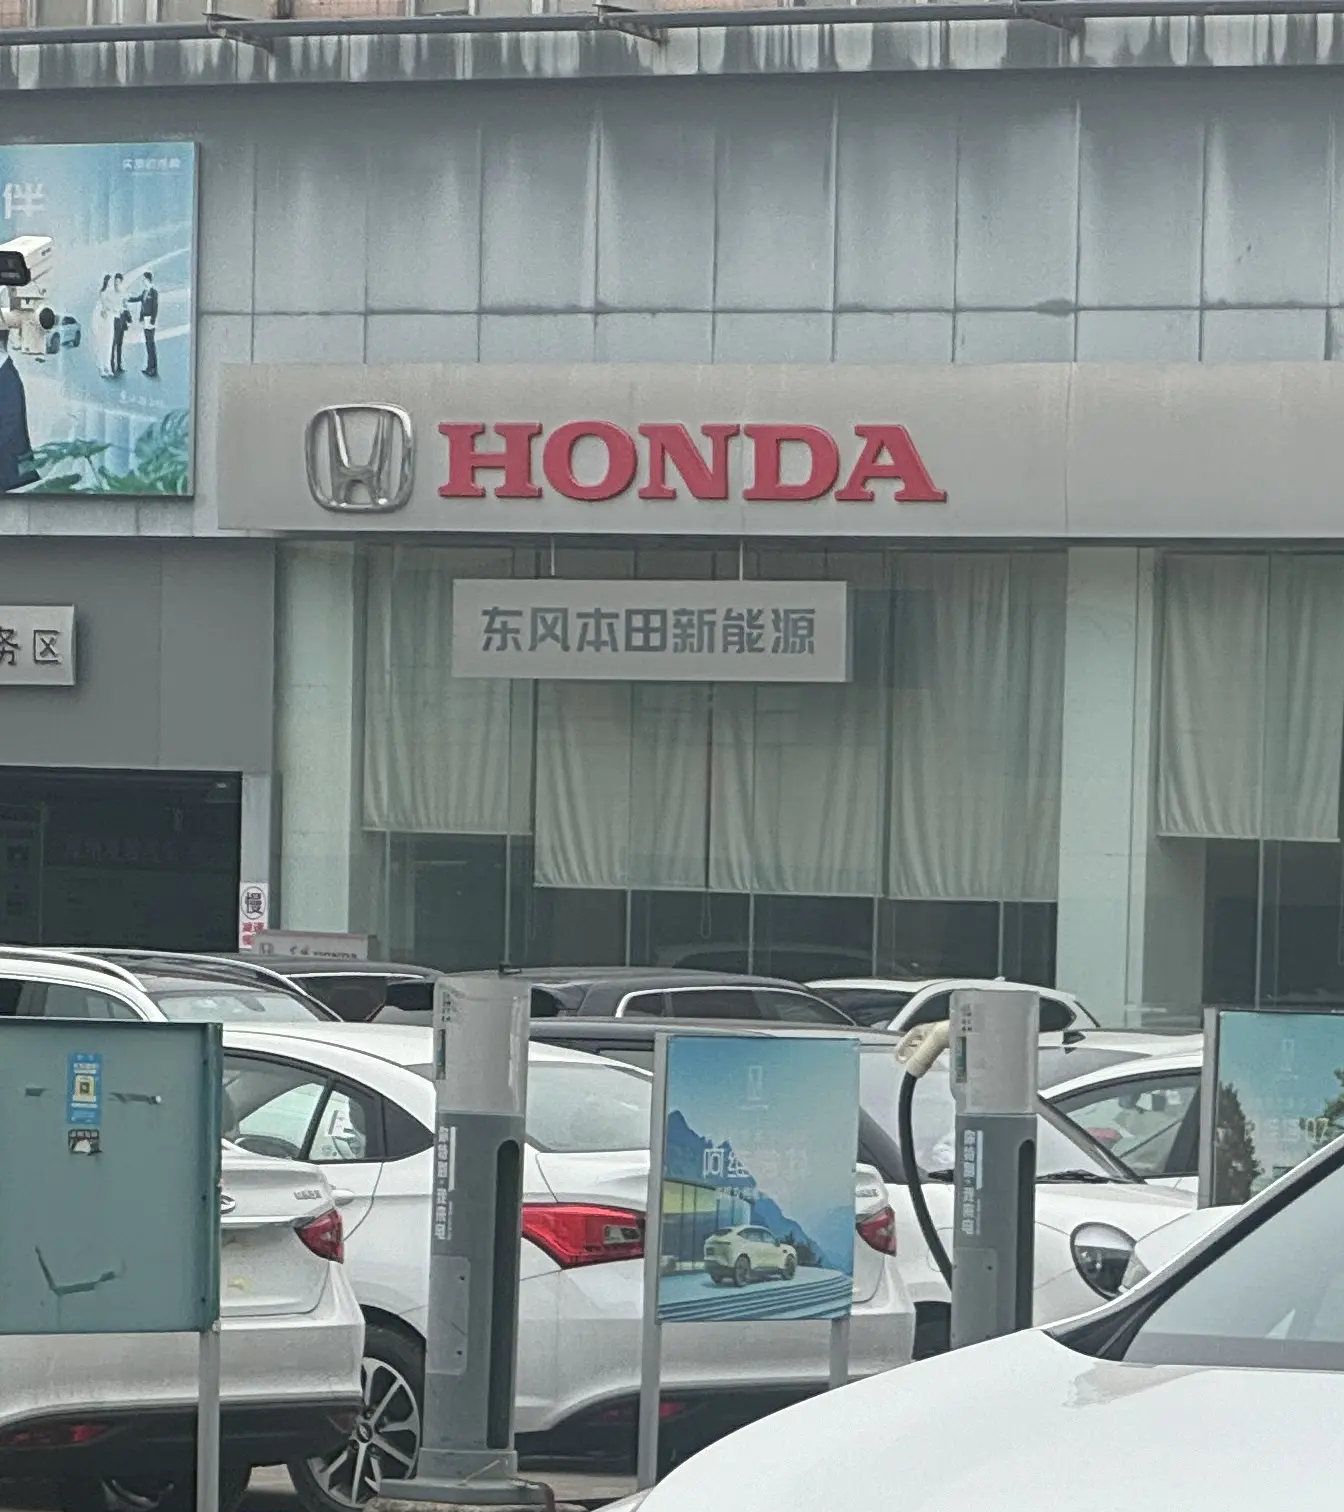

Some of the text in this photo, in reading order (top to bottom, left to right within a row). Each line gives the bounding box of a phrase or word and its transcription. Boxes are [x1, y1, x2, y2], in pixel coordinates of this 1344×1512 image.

[438, 420, 946, 502] HONDA
[481, 605, 817, 655] 东风本田新能源
